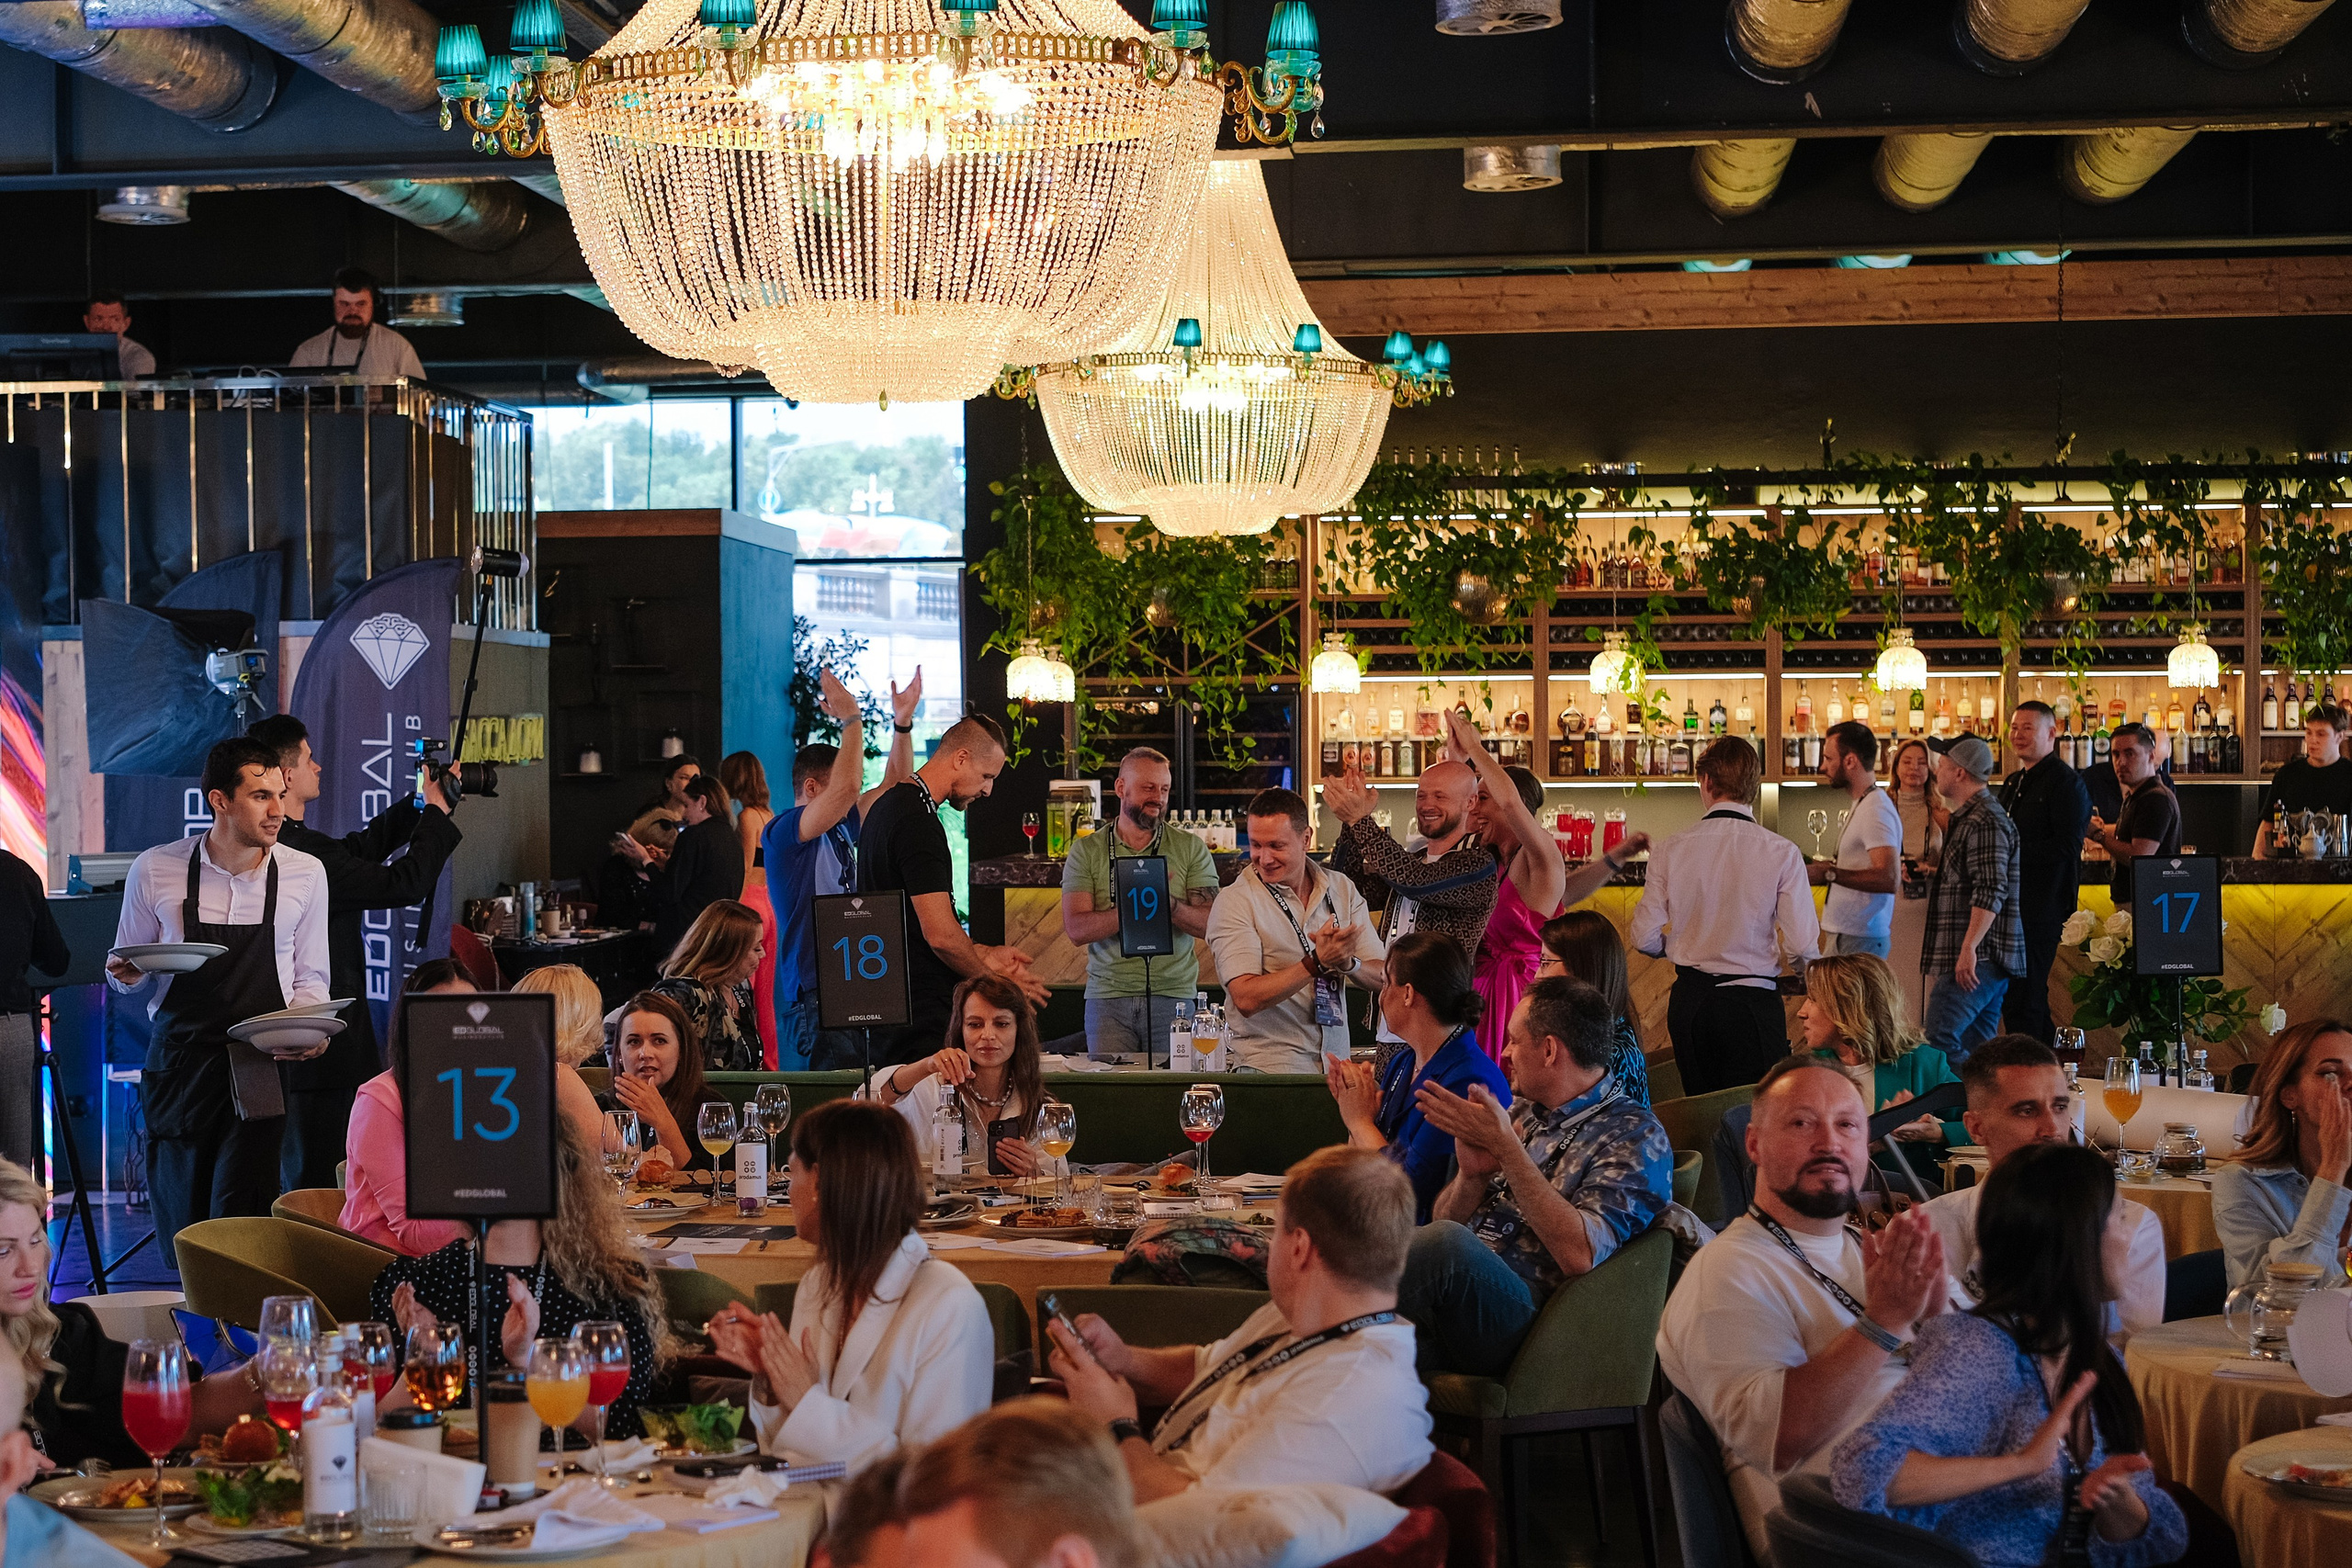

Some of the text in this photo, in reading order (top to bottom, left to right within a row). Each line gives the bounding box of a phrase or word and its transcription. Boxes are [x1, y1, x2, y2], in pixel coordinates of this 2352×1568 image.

[1127, 886, 1158, 920] 19
[2152, 893, 2200, 933] 17
[832, 934, 888, 981] 18
[437, 1067, 520, 1141] 13
